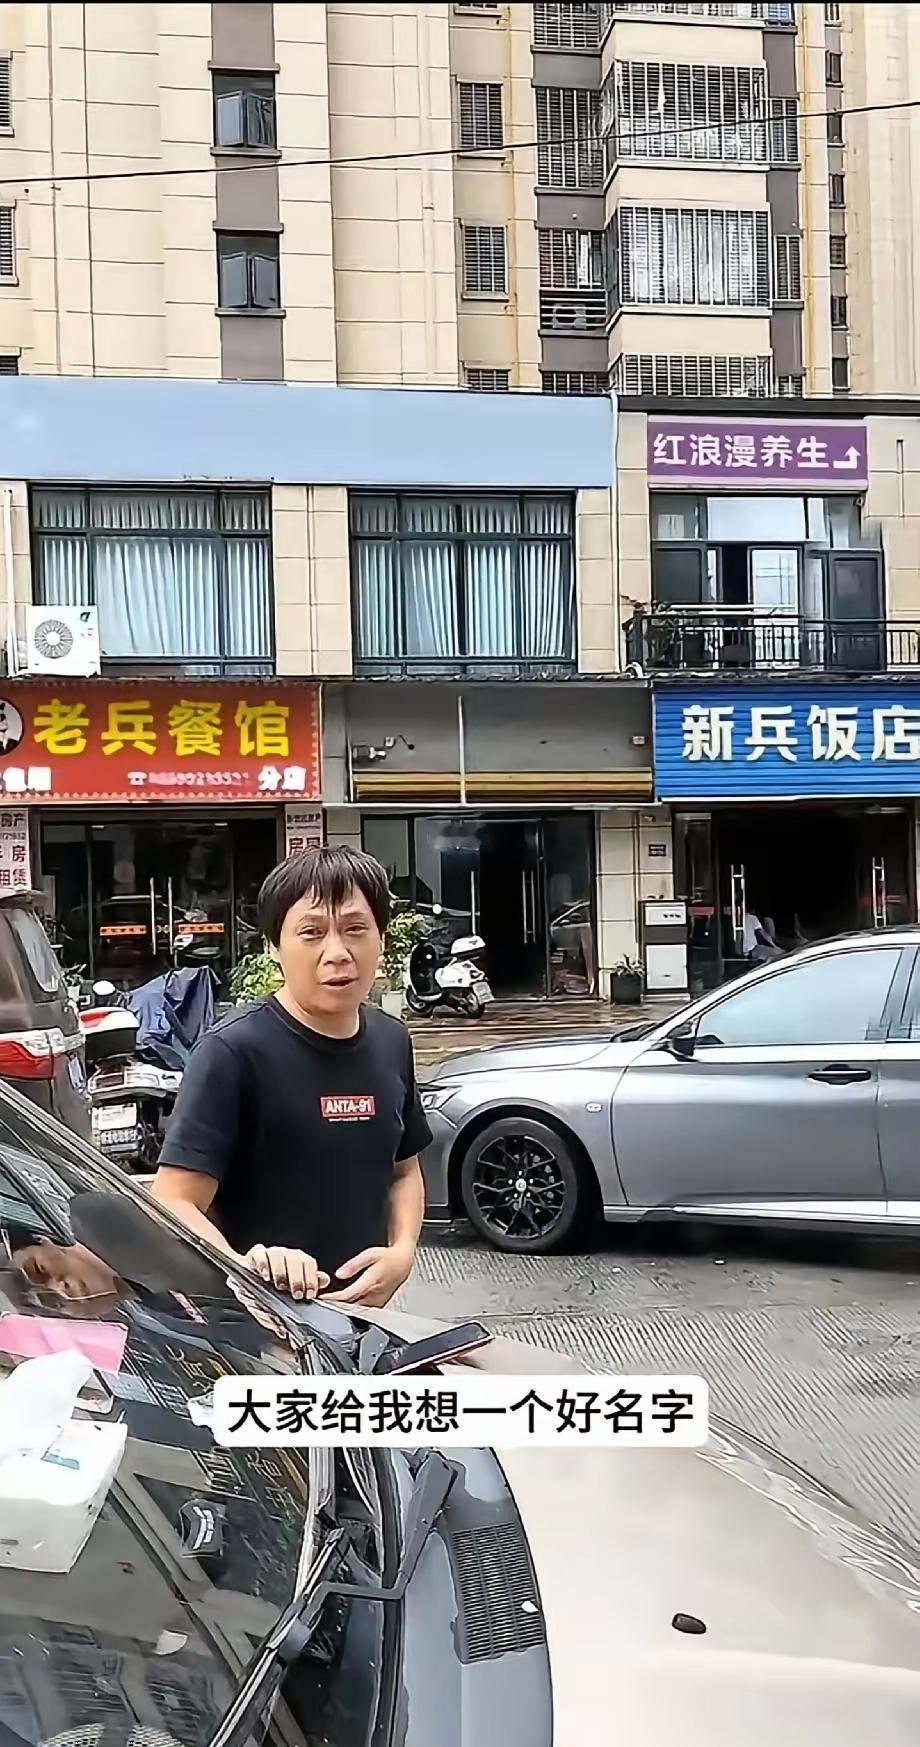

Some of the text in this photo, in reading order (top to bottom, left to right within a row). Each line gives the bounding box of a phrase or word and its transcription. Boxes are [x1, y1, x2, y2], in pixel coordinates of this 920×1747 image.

[653, 433, 829, 468] 红浪漫养生
[33, 698, 290, 757] 老兵餐馆
[682, 704, 920, 762] 新兵饭店
[326, 1098, 371, 1113] ANTA-91
